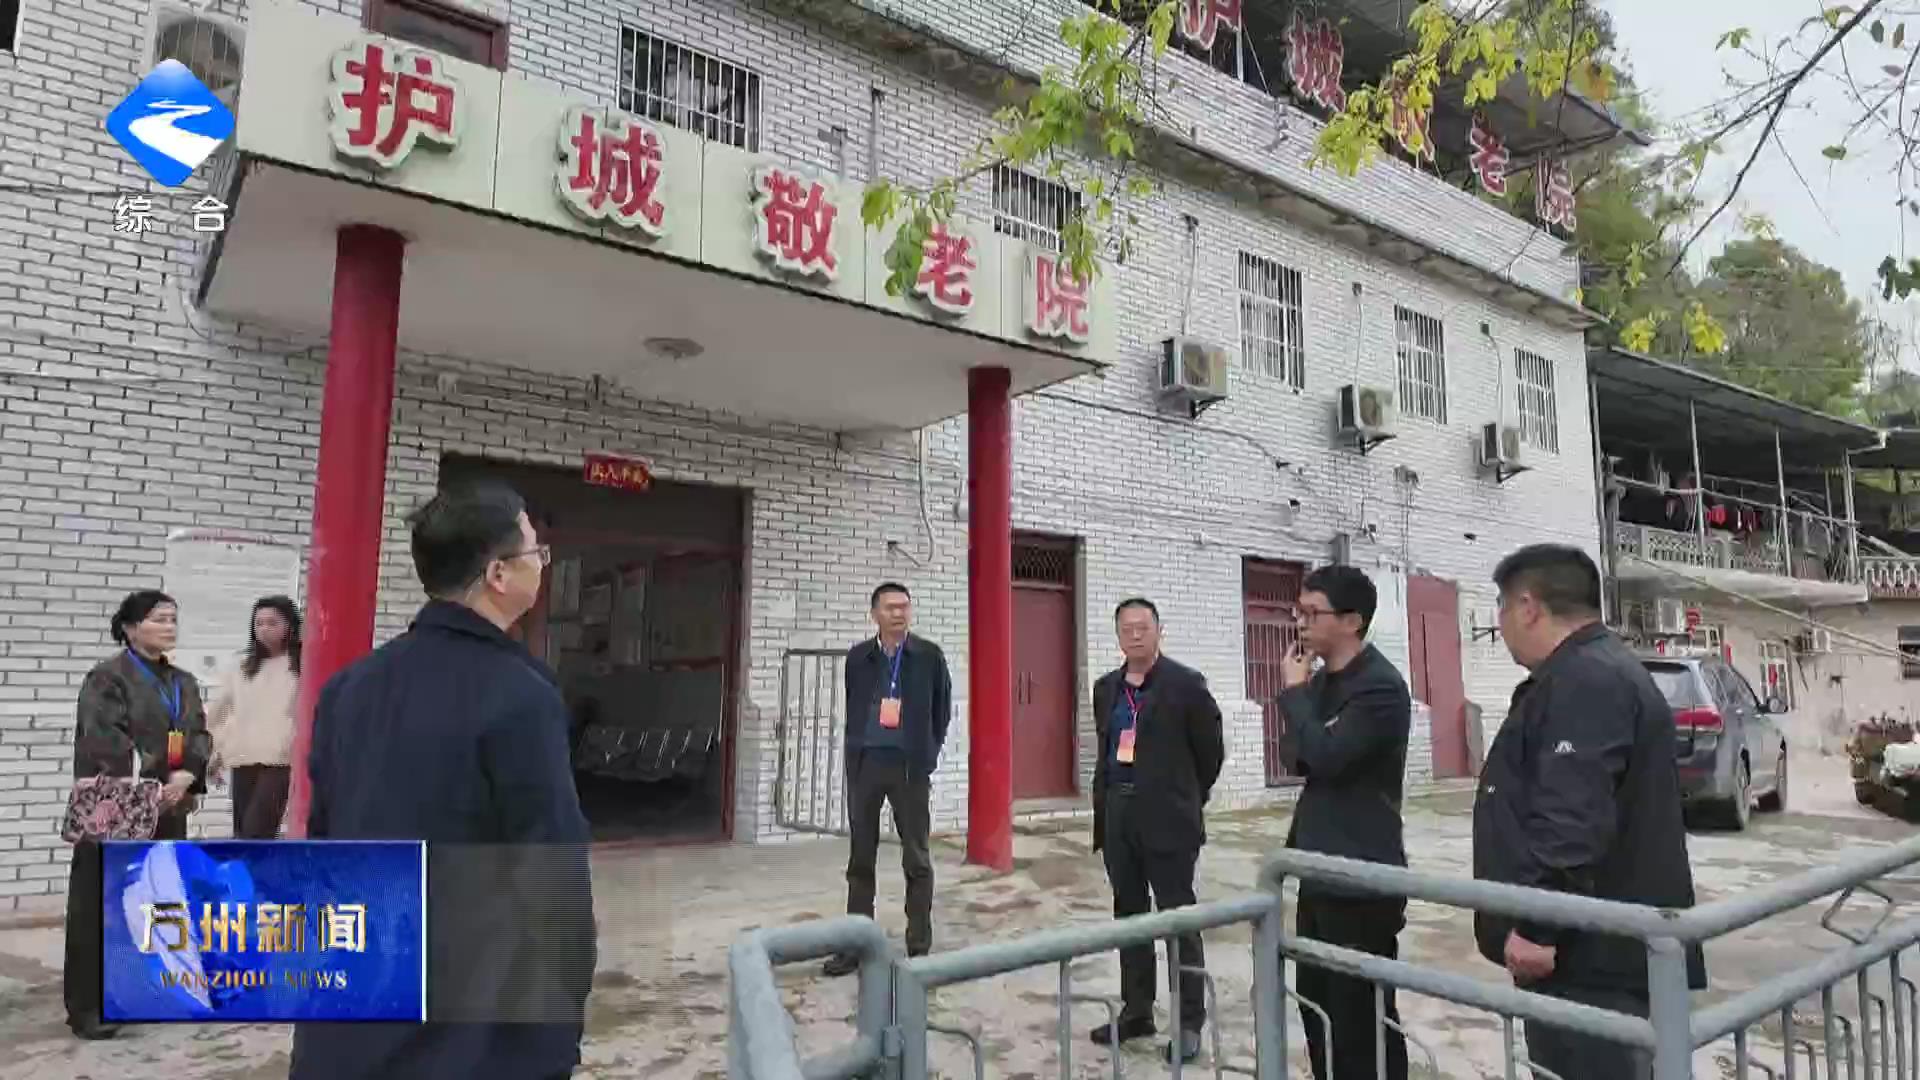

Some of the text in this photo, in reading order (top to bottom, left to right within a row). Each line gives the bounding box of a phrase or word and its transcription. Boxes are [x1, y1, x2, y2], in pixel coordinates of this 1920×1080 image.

[342, 43, 1088, 338] 护城敬老院
